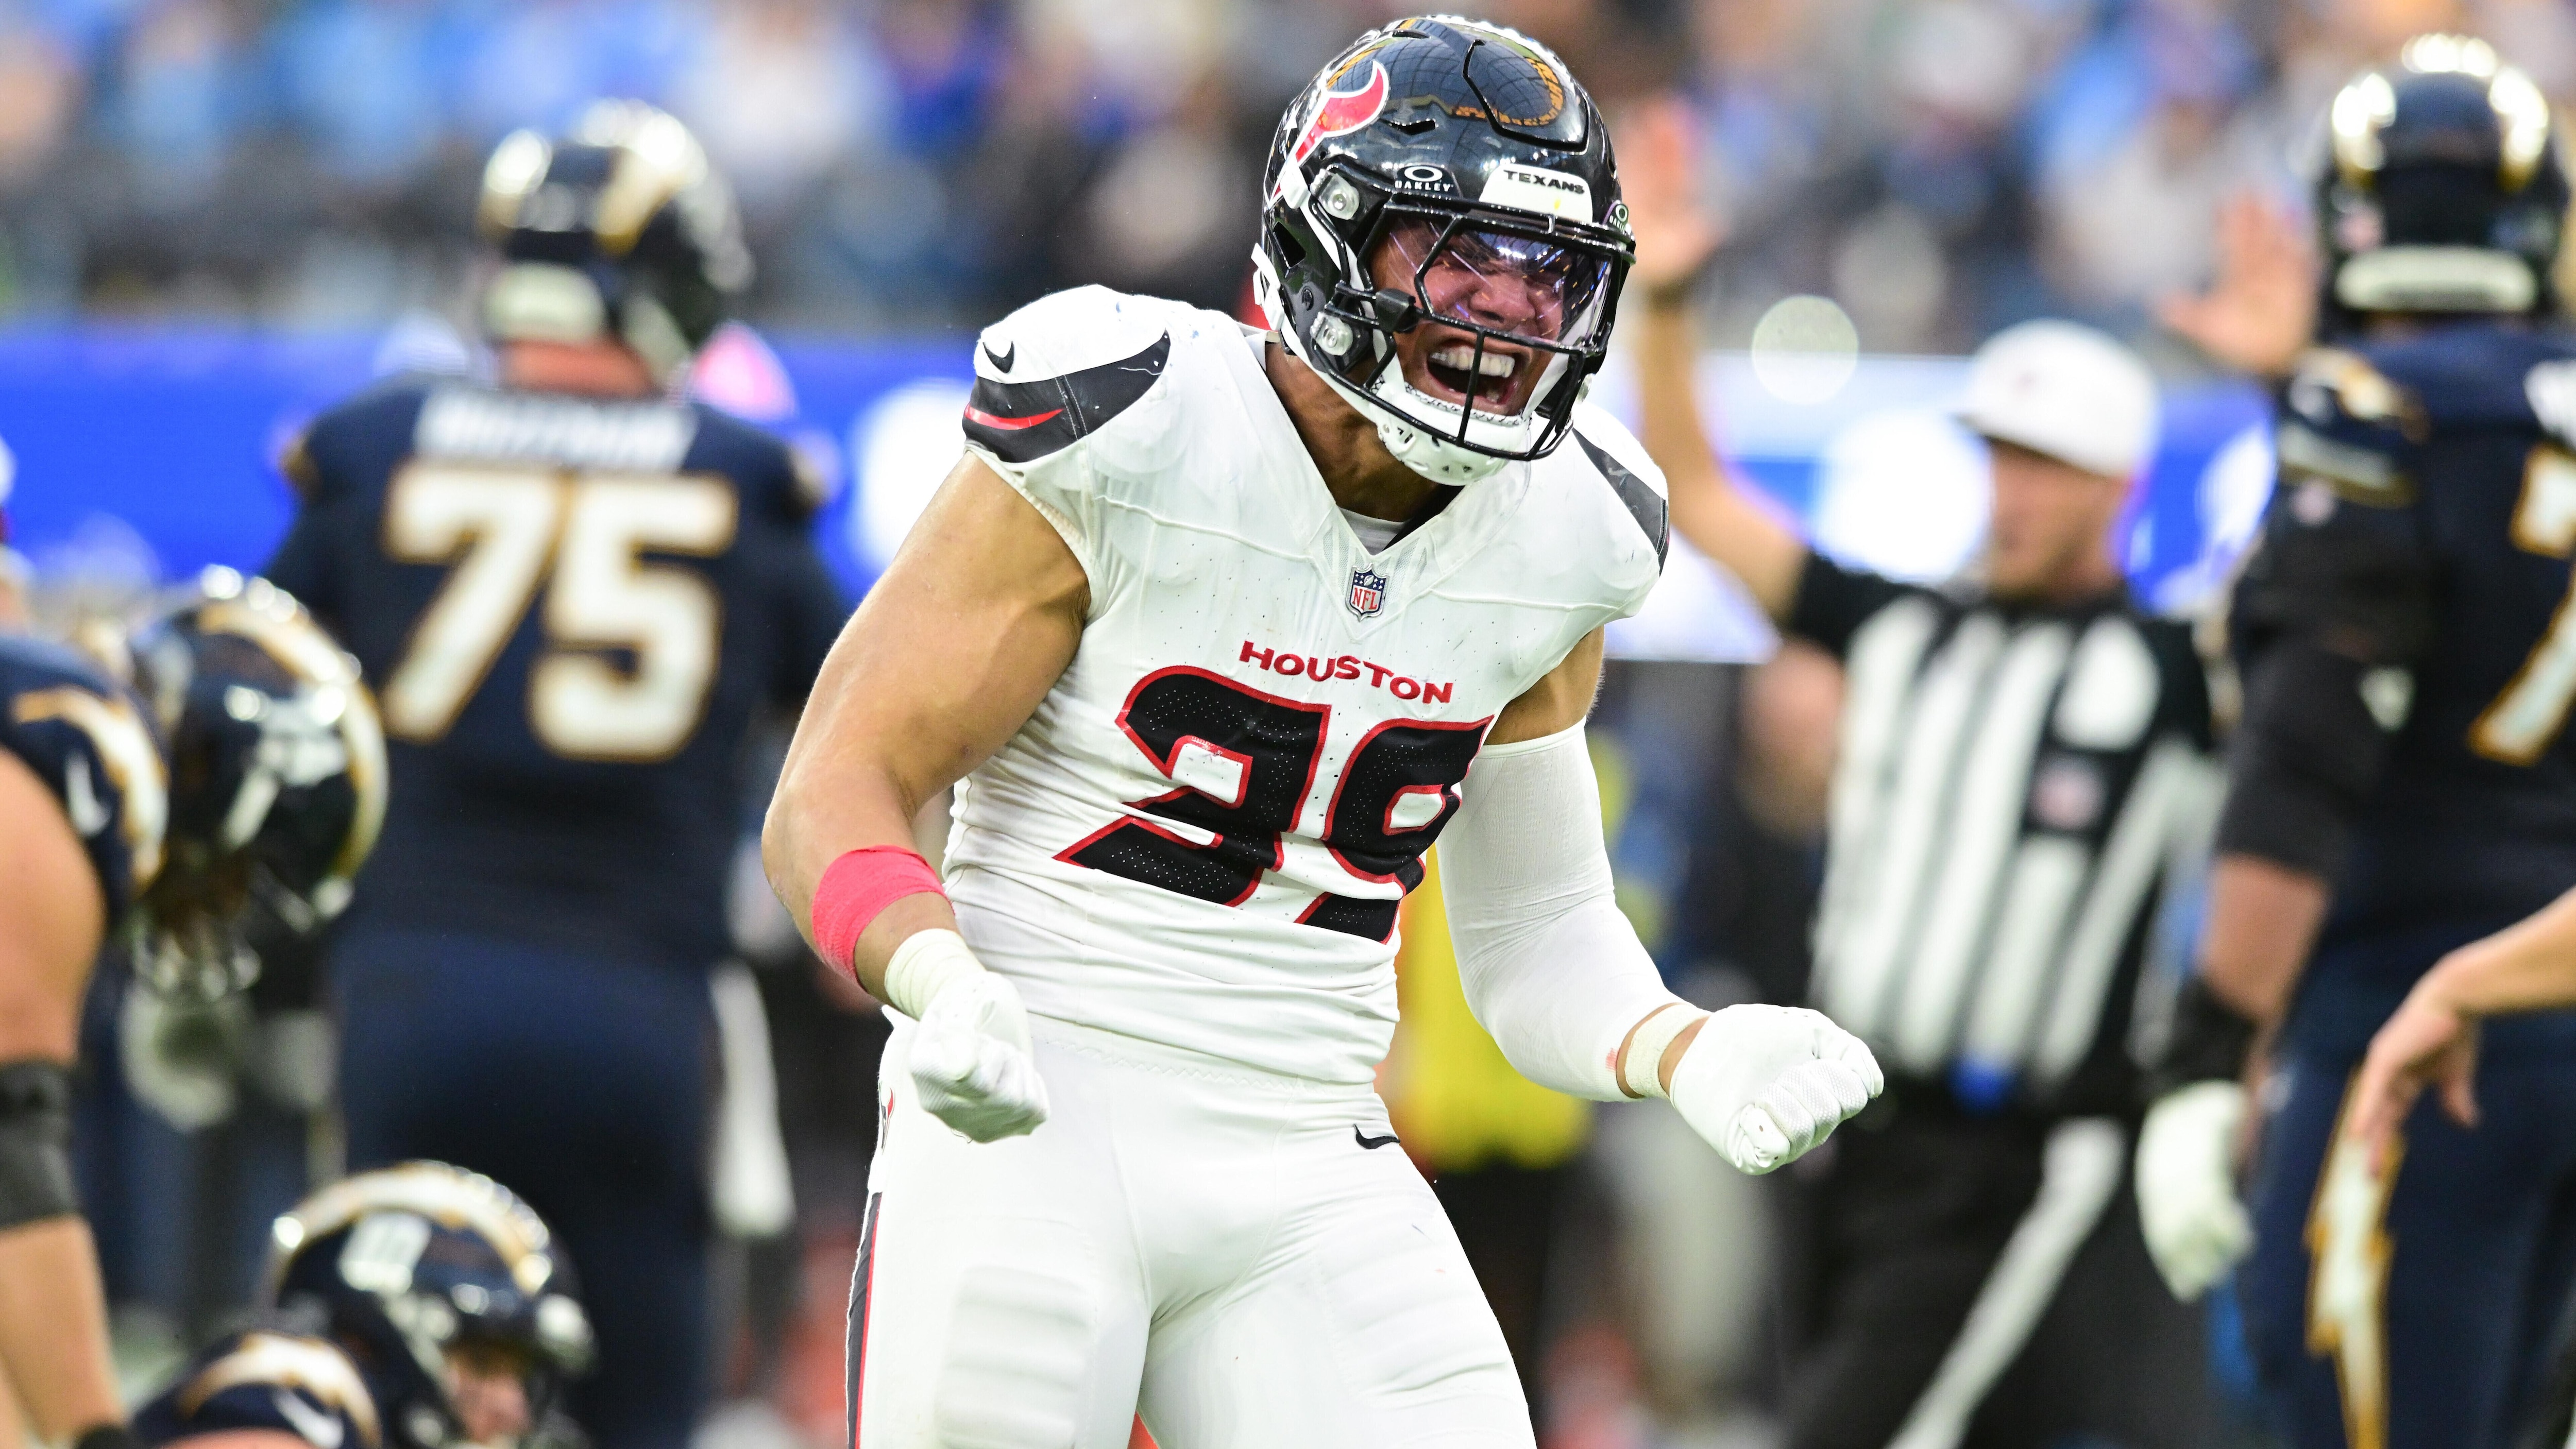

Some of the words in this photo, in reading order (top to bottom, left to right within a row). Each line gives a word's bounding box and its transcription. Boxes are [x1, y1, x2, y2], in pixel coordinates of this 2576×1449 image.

[1395, 180, 1452, 192] OAKLEY
[1503, 170, 1585, 194] TEXANS
[383, 459, 739, 764] 75
[1352, 587, 1377, 610] NFL
[1239, 640, 1453, 704] HOUSTON
[1052, 664, 1495, 945] 39
